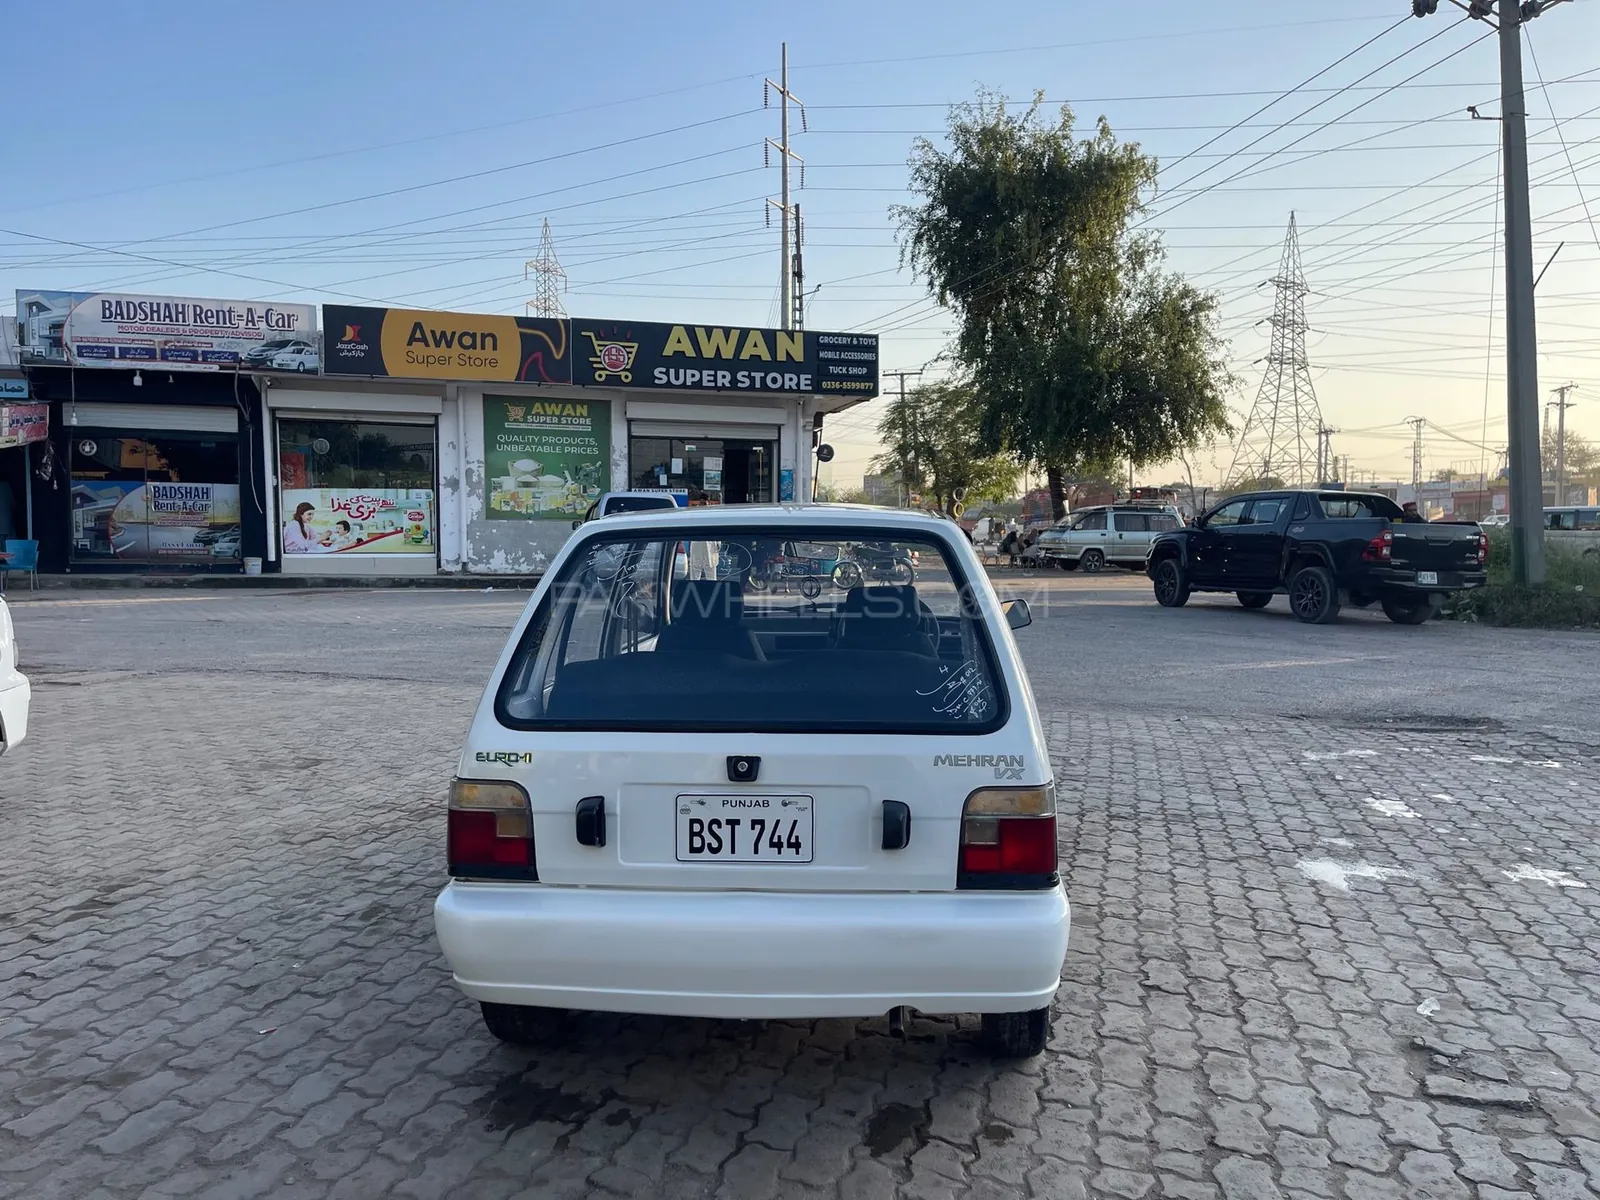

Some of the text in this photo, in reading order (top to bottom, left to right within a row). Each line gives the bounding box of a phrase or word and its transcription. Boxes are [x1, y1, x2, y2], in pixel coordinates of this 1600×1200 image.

[101, 299, 297, 328] BADSHAH Rent-A-Car
[117, 325, 145, 333] MOTOR
[146, 326, 180, 334] DEALERS
[188, 328, 229, 336] PROPERTY
[230, 330, 263, 338] ADVISOR
[406, 321, 499, 351] Awan
[335, 342, 369, 350] JazzCash
[662, 325, 804, 363] AWAN
[818, 335, 877, 346] GROCERY & TOYS
[405, 350, 499, 368] Super Store
[819, 350, 877, 360] MOBILE ACCESSORIES
[828, 365, 868, 375] TUCK SHOP
[653, 367, 813, 391] SUPER STORE
[531, 402, 588, 417] AWAN
[527, 415, 592, 425] SUPER STORE
[496, 434, 599, 446] QUALITY PRODUCTS,
[496, 443, 599, 455] UNBEATABLE PRICES
[153, 485, 210, 500] BADSHAH
[153, 501, 211, 512] Rent-A-Car
[933, 753, 1025, 768] MEHRAN
[993, 767, 1026, 780] VX
[721, 799, 771, 808] PUNJAB
[688, 817, 802, 856] BST 744
